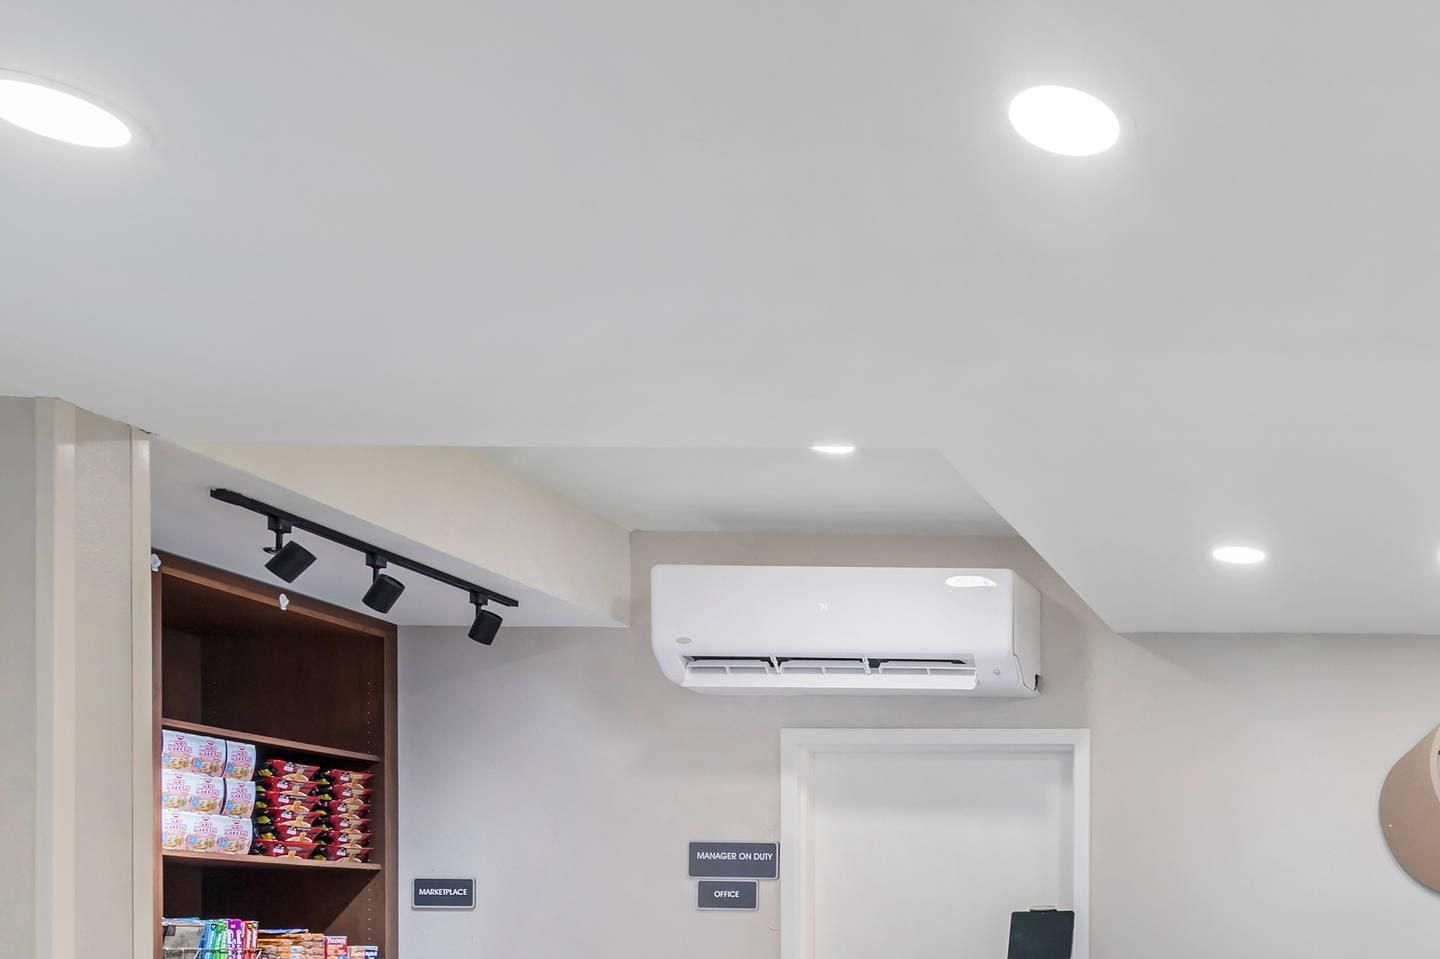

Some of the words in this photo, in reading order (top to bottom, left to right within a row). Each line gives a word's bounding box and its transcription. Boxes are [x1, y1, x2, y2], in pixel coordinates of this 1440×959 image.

[696, 851, 737, 861] MANAGER
[739, 851, 752, 861] ON
[753, 851, 774, 861] DUTY
[418, 888, 468, 896] MARKETPLACE
[713, 890, 740, 898] OFFICE
